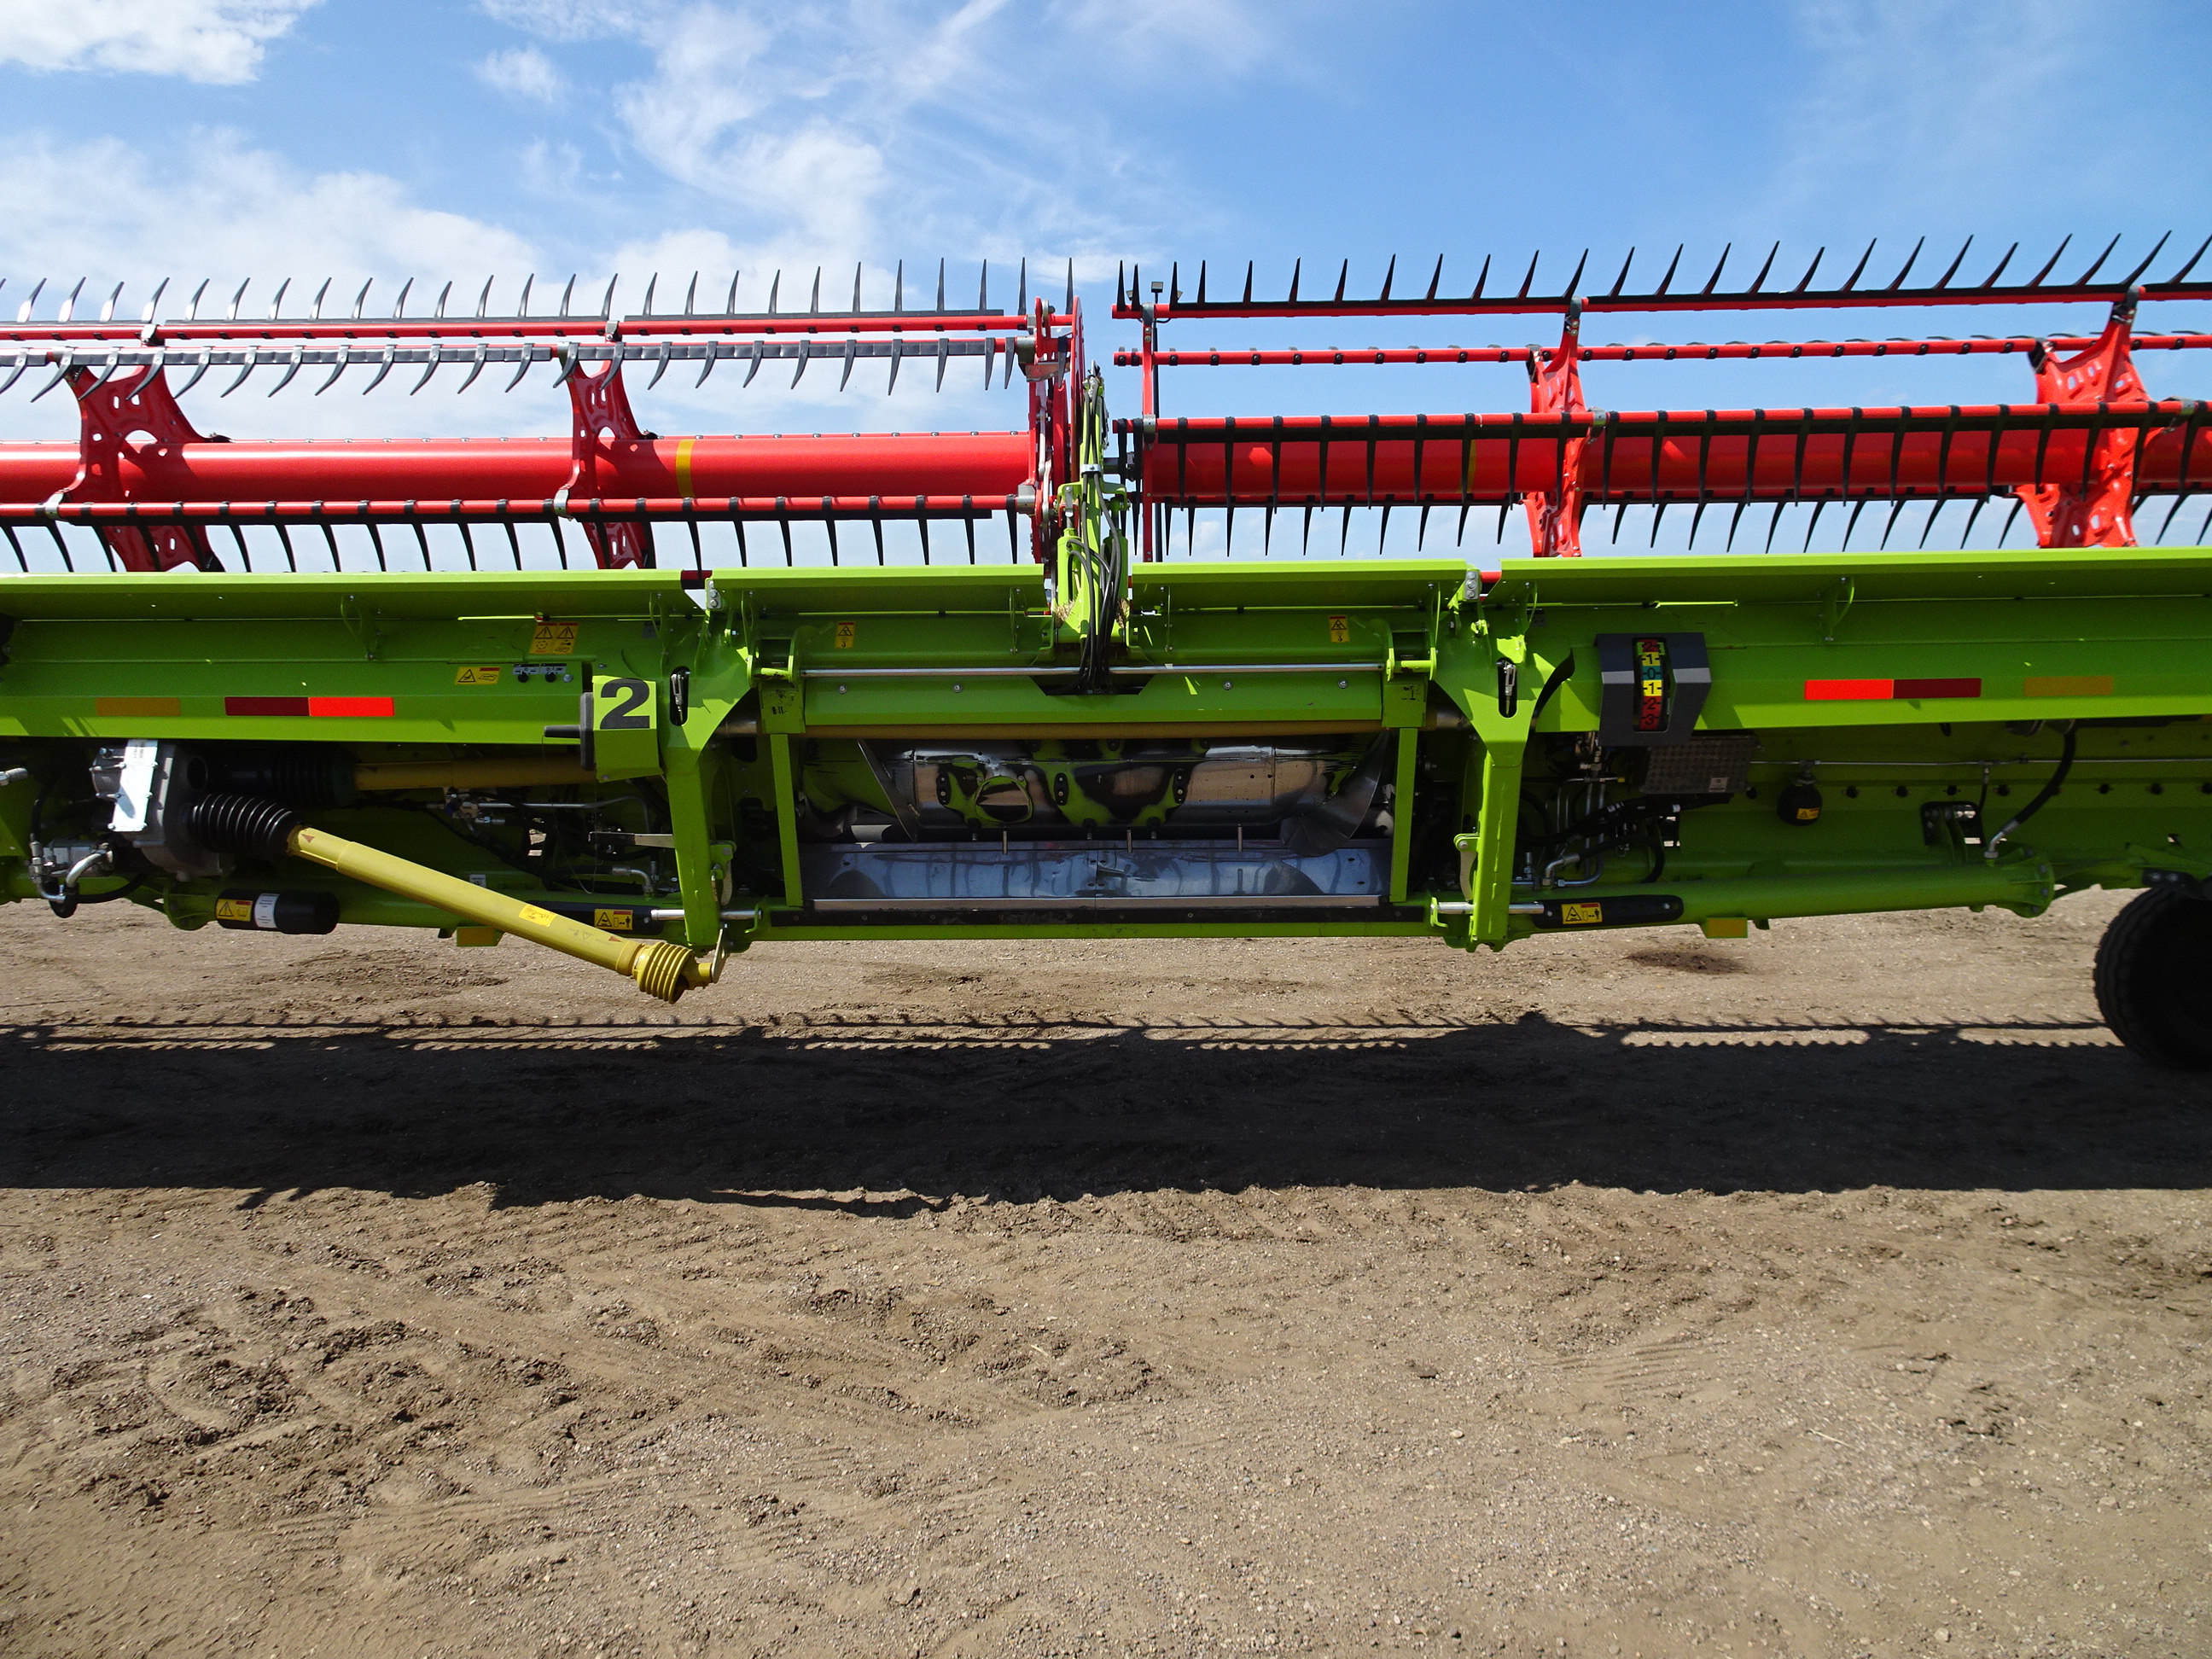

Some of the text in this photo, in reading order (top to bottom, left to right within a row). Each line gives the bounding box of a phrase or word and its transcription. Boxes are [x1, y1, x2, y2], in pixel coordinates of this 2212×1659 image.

[1645, 653, 1653, 665] 1
[1647, 667, 1656, 679] 0
[1648, 682, 1655, 694] 1
[600, 678, 650, 730] 2
[1647, 697, 1656, 709] 2
[1645, 713, 1655, 725] 3
